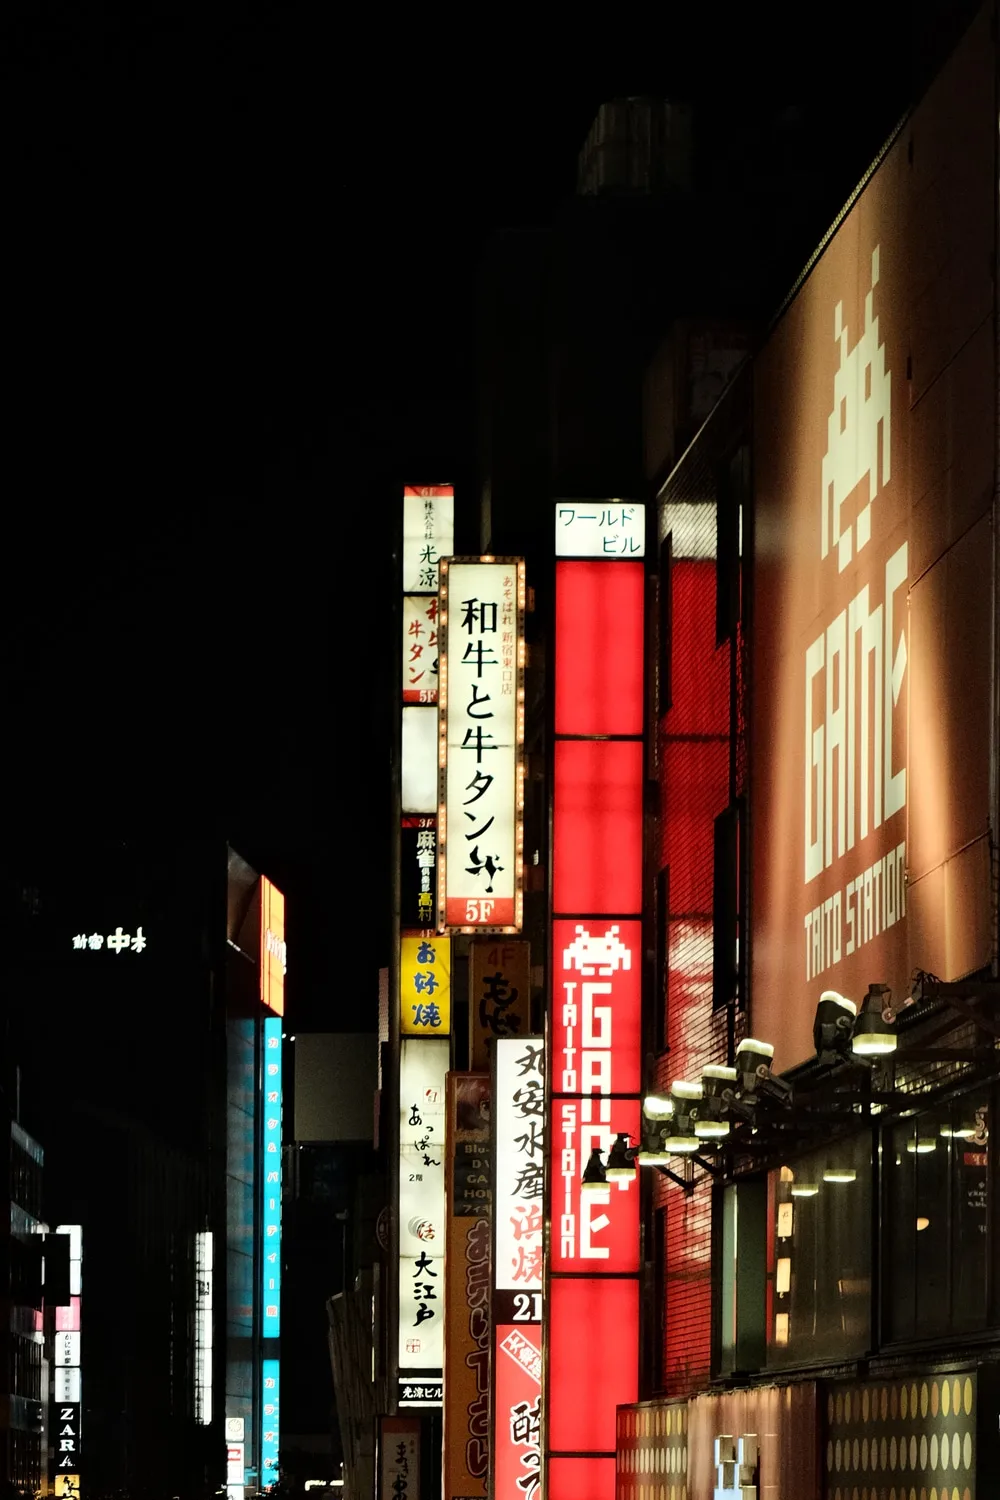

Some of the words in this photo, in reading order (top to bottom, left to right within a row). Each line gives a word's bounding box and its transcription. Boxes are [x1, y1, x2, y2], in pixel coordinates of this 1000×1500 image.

[559, 508, 635, 528] ワールド
[602, 536, 641, 554] ビル
[419, 689, 437, 703] 5F
[460, 597, 499, 841] 和牛と牛タン
[804, 541, 909, 885] GAME
[465, 899, 495, 923] 5F
[804, 890, 842, 982] TAITO
[845, 840, 906, 957] STATION
[413, 941, 442, 1027] お好焼
[562, 982, 577, 1093] TAITO
[560, 1104, 576, 1259] STATION
[412, 1251, 438, 1327] 大江戸
[59, 1408, 76, 1468] ZARA
